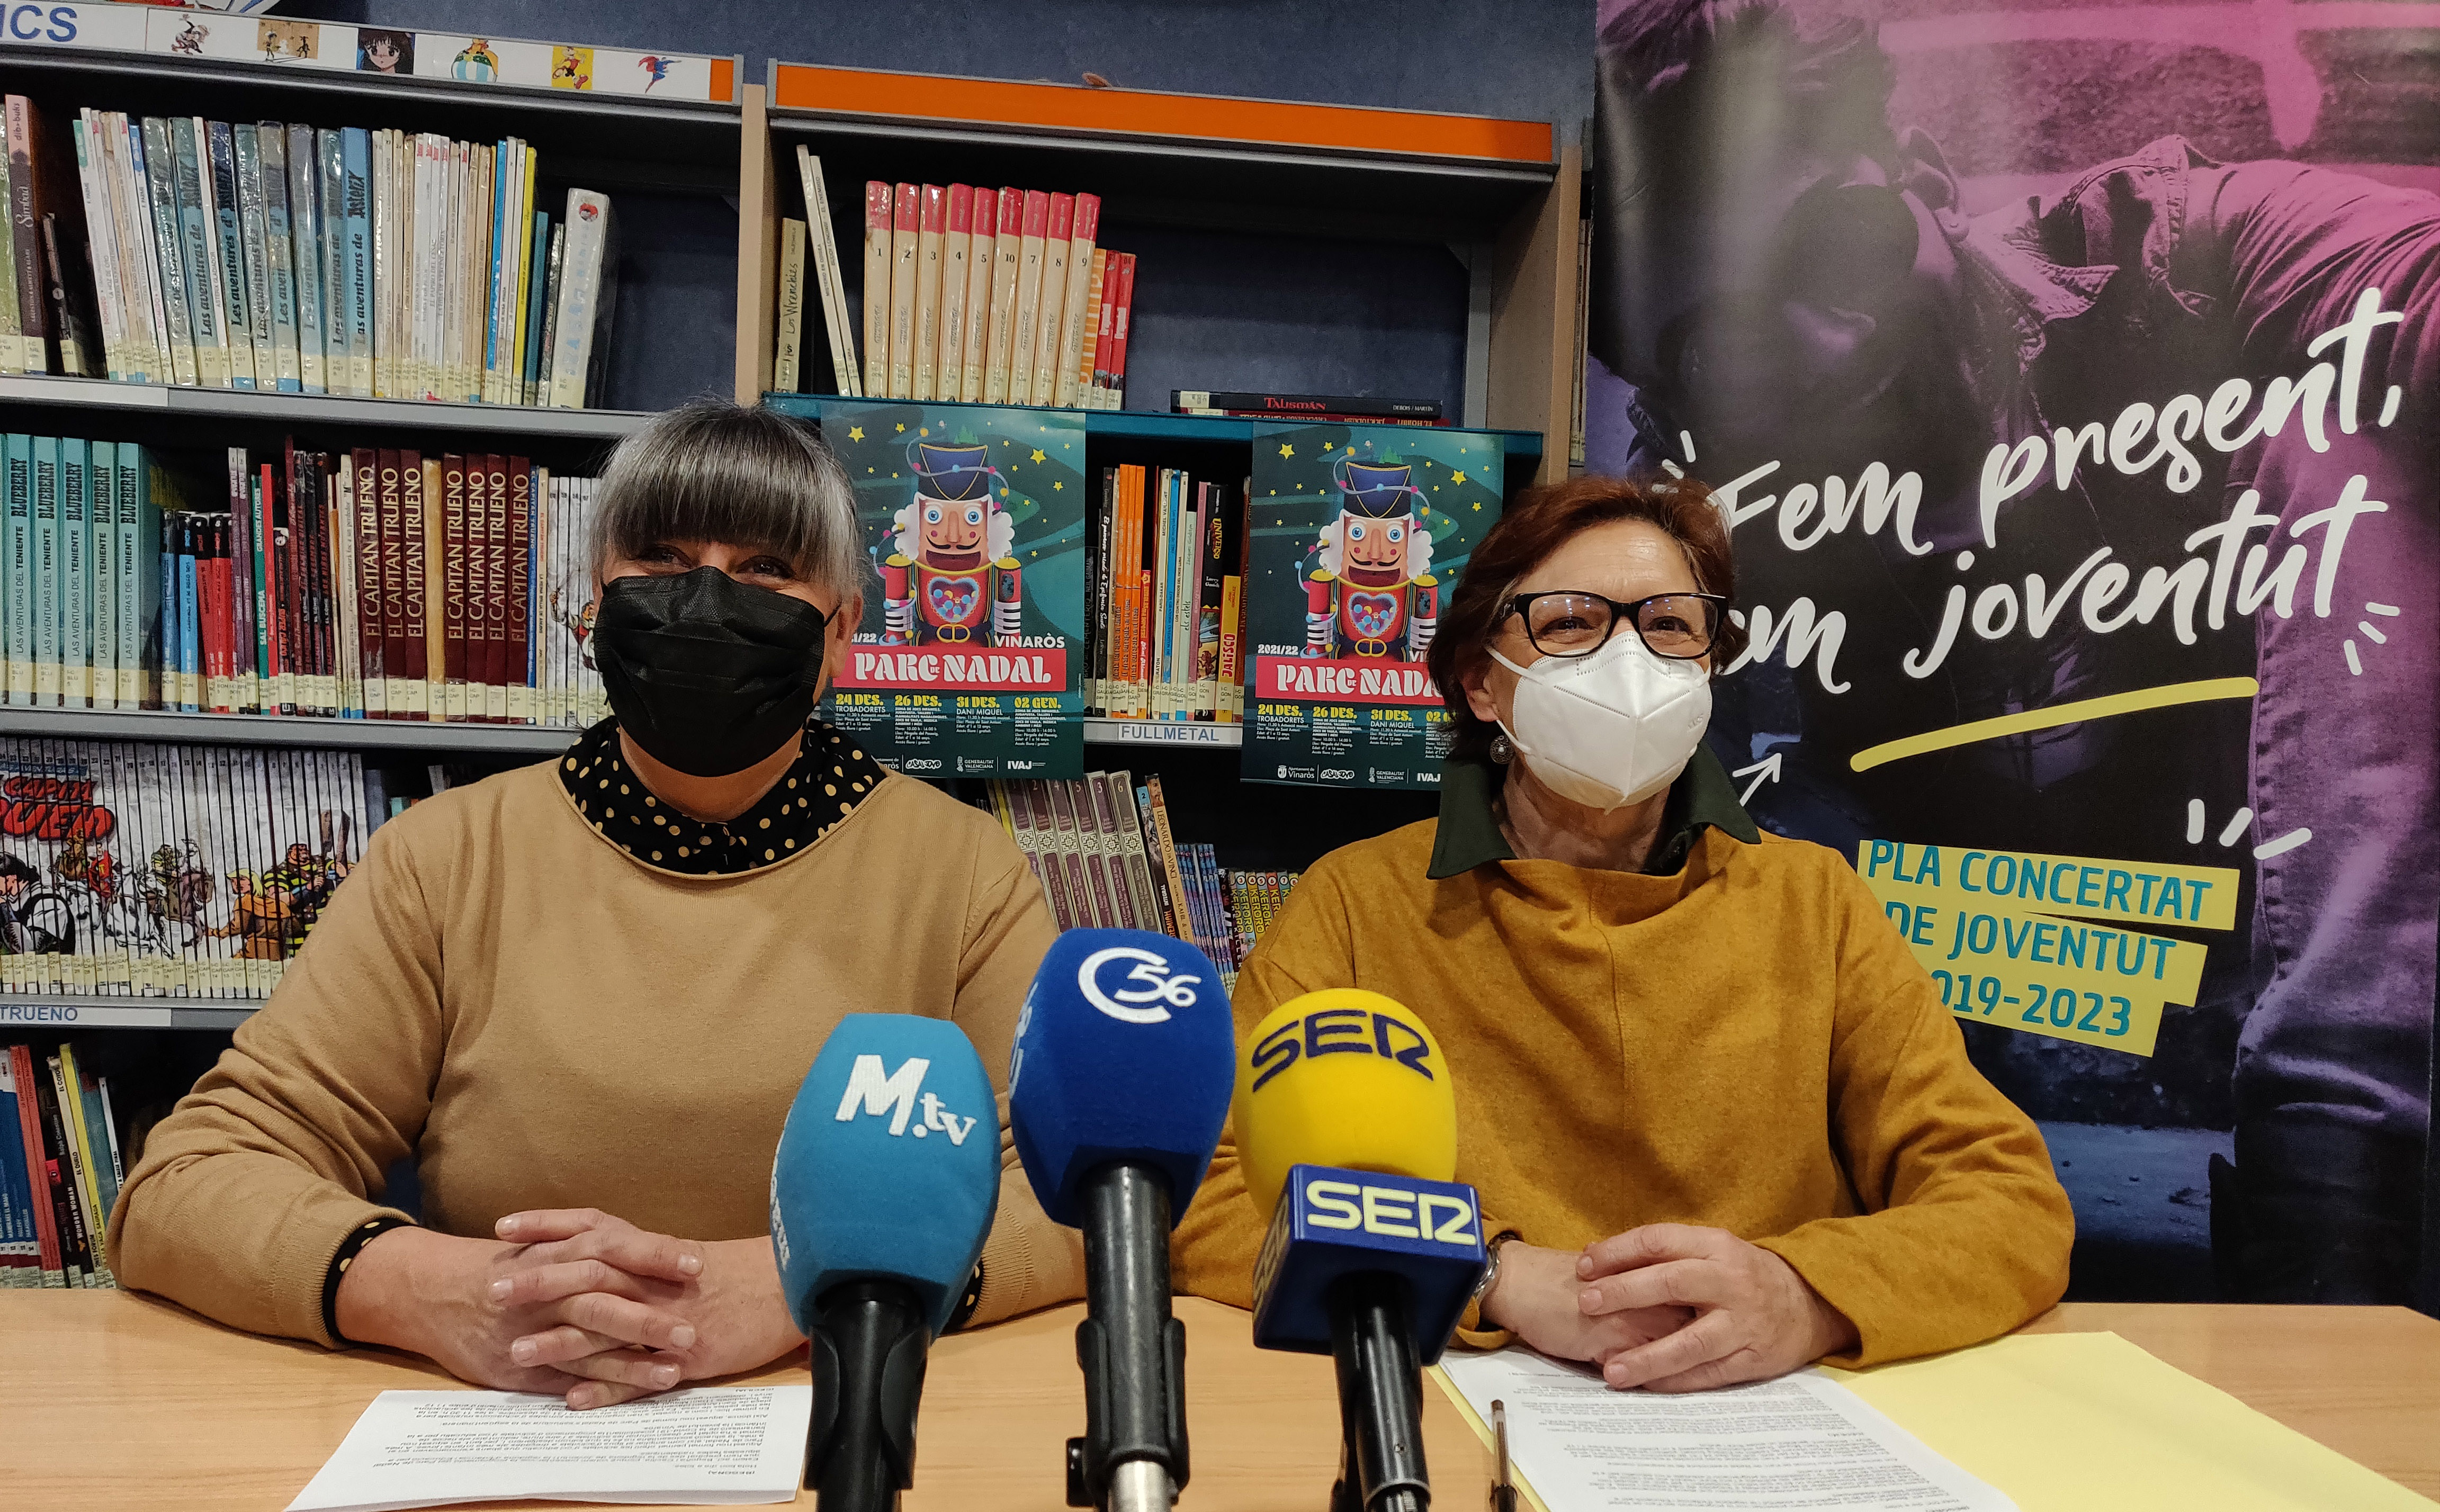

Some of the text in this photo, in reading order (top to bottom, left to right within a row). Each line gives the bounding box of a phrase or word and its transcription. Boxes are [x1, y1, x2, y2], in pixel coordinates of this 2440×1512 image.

[930, 251, 936, 260] 3
[955, 251, 962, 260] 4
[981, 254, 987, 263] 5
[1005, 254, 1016, 263] 10
[1030, 255, 1036, 264] 7
[1055, 258, 1062, 267] 8
[1082, 258, 1088, 267] 9
[190, 224, 212, 337] Las aventuras de
[226, 235, 243, 326] Les aventures
[352, 233, 365, 320] aventuras de
[784, 263, 798, 317] Wrenchies
[1707, 286, 2403, 556] Fem present,
[11, 457, 28, 518] BLUEBERRY
[38, 460, 55, 520] BLUEBERRY
[66, 462, 83, 521] BLUEBERRY
[94, 465, 110, 524] BLUEBERRY
[120, 465, 137, 525] BLUEBERRY
[358, 466, 382, 637] EL CAPITAN TRUENO
[381, 467, 403, 638] EL CAPITAN TRUENO
[403, 467, 424, 638] EL CAPITAN TRUENO
[446, 470, 464, 640] EL CAPITAN TRUENO
[468, 471, 486, 641] EL CAPITAN TRUENO
[488, 471, 507, 641] EL CAPITAN TRUENO
[510, 474, 529, 643] EL CAPITAN TRUENO
[1212, 518, 1222, 560] UNIVERSO
[1903, 474, 2388, 680] joventut
[258, 590, 266, 629] BUSCEMA
[1181, 601, 1191, 631] els estels
[994, 632, 1065, 649] VINARÒS
[1258, 644, 1299, 655] 2021/22
[854, 652, 1052, 683] PARC DE NADAL
[1277, 664, 1356, 695] PARC
[836, 694, 884, 706] 24 DES.
[895, 695, 943, 707] 26 DES.
[956, 696, 1000, 708] 31 DES.
[1014, 697, 1062, 709] 02 GEN.
[1257, 715, 1305, 724] TROBADORETS
[1258, 704, 1303, 717] 24 DES.
[1313, 706, 1358, 719] 26 DES.
[1370, 709, 1413, 722] 31 DES.
[1425, 711, 1441, 723] 02
[1121, 724, 1220, 743] FULLMETAL
[1388, 721, 1415, 730] MIQUEL
[1007, 760, 1032, 770] IVAJ
[1288, 770, 1315, 779] Vinaròs
[1416, 772, 1441, 782] IVAJ
[1156, 809, 1177, 879] LEONARDO VINCI
[1868, 839, 2213, 922] PLA CONCERTAT
[1239, 889, 1253, 933] KERORO
[1249, 889, 1266, 933] KERORO
[1885, 901, 2177, 980] DE JOVENTUT
[0, 1006, 78, 1021] TRUENO
[1931, 969, 2132, 1037] 019-2023
[1251, 1009, 1434, 1094] SER
[1306, 1180, 1478, 1246] SER
